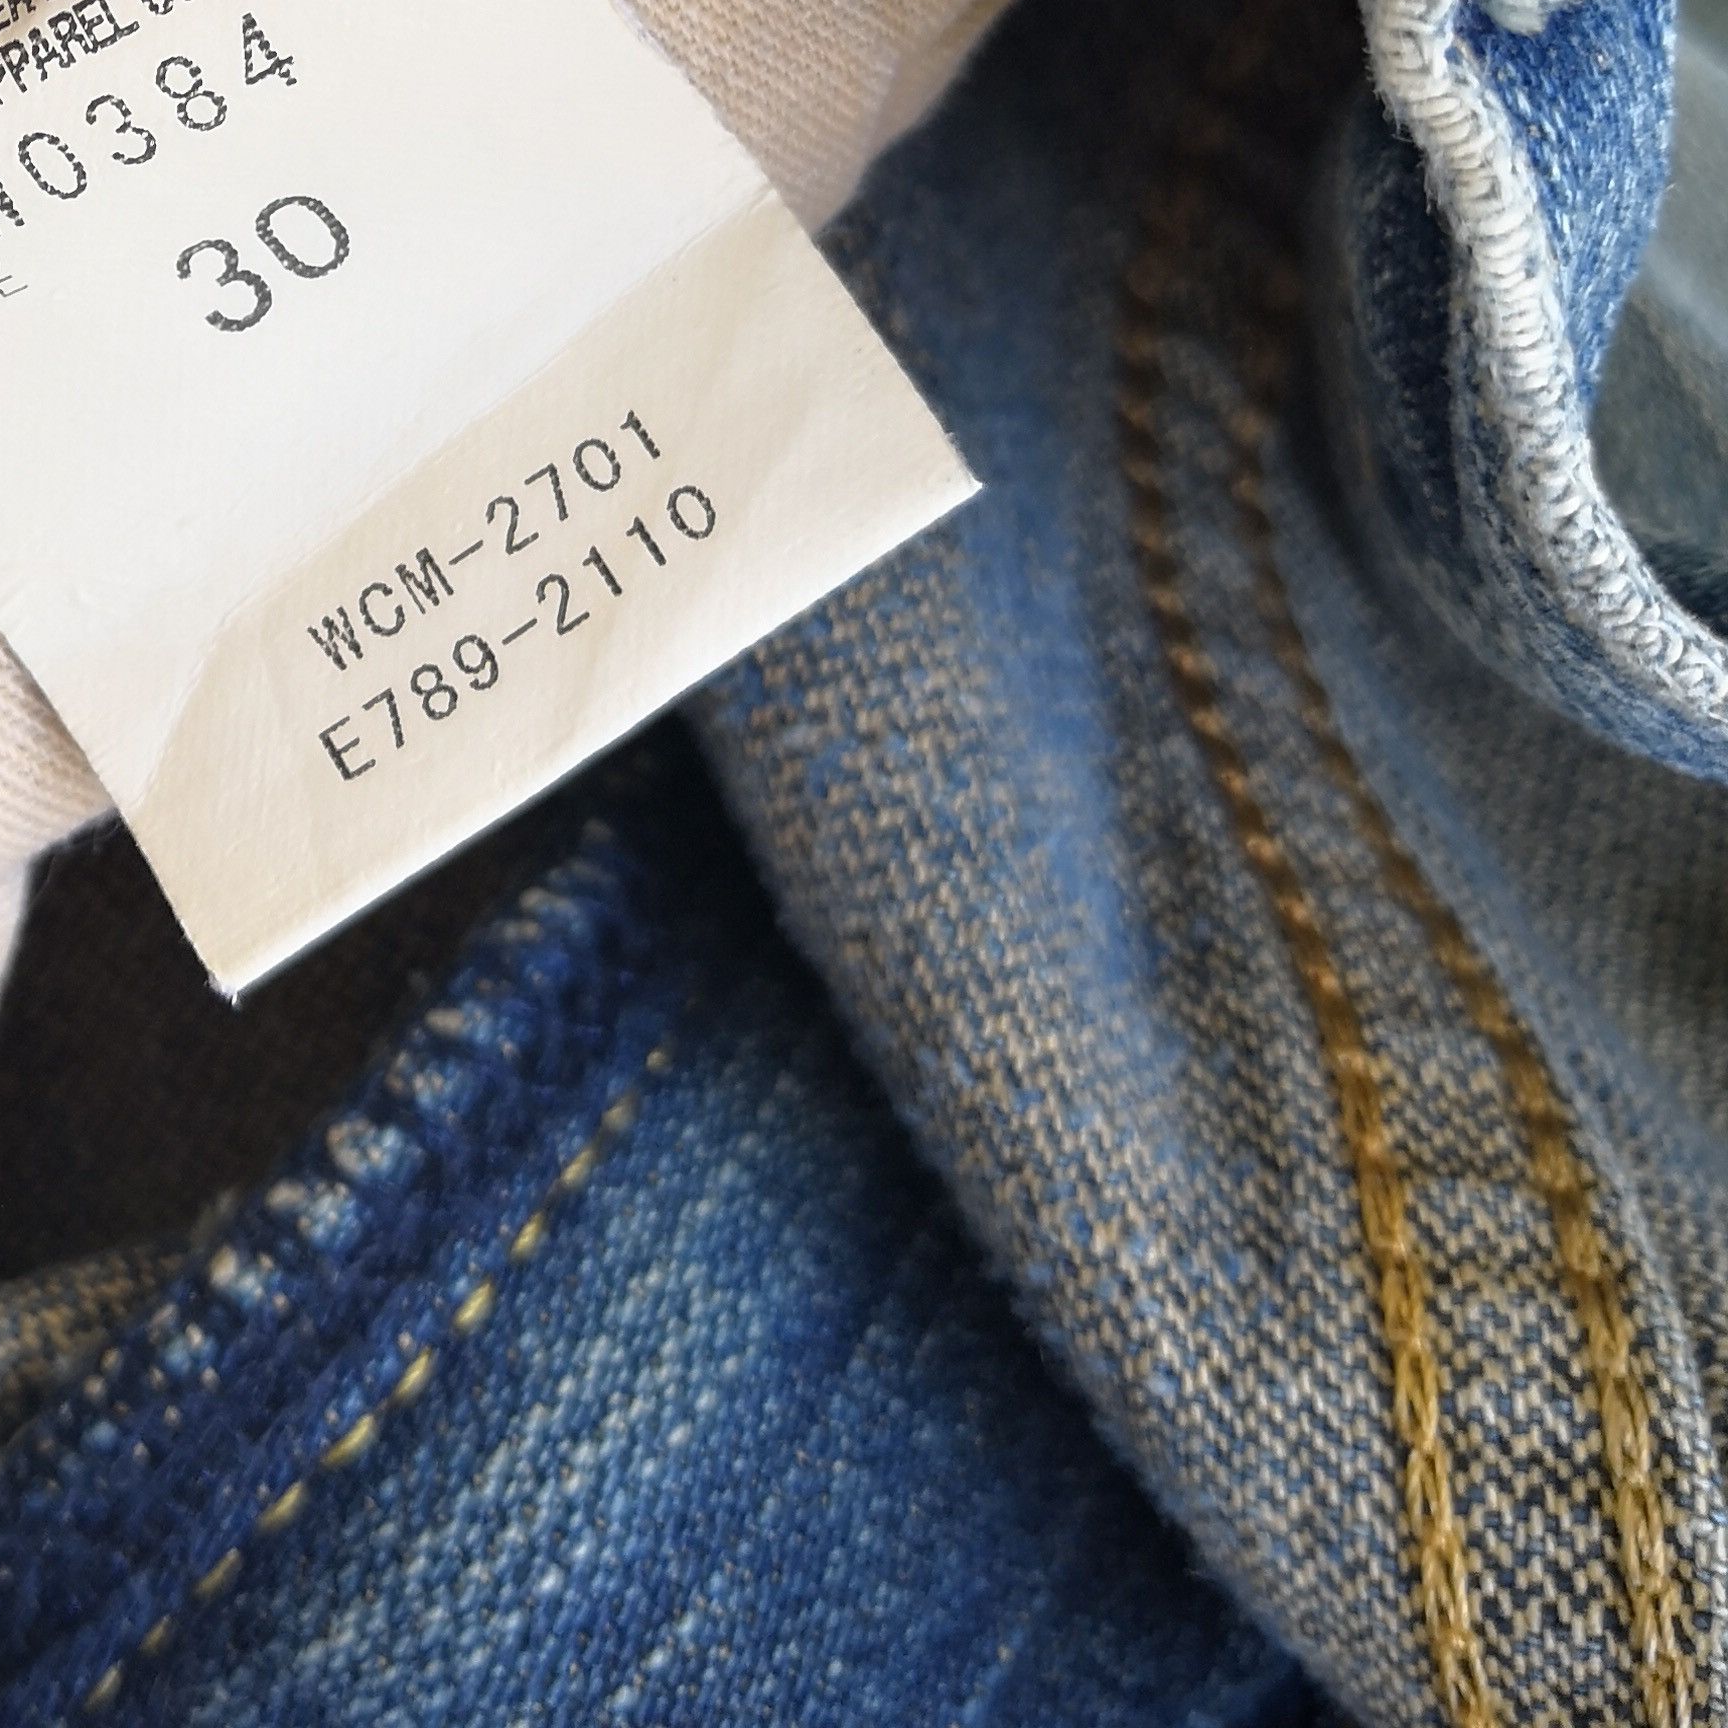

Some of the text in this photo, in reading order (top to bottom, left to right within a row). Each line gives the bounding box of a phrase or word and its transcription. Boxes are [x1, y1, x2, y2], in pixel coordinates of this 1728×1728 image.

[176, 195, 351, 332] 30
[307, 410, 661, 671] WCM-2701
[319, 485, 716, 781] E789-2110
